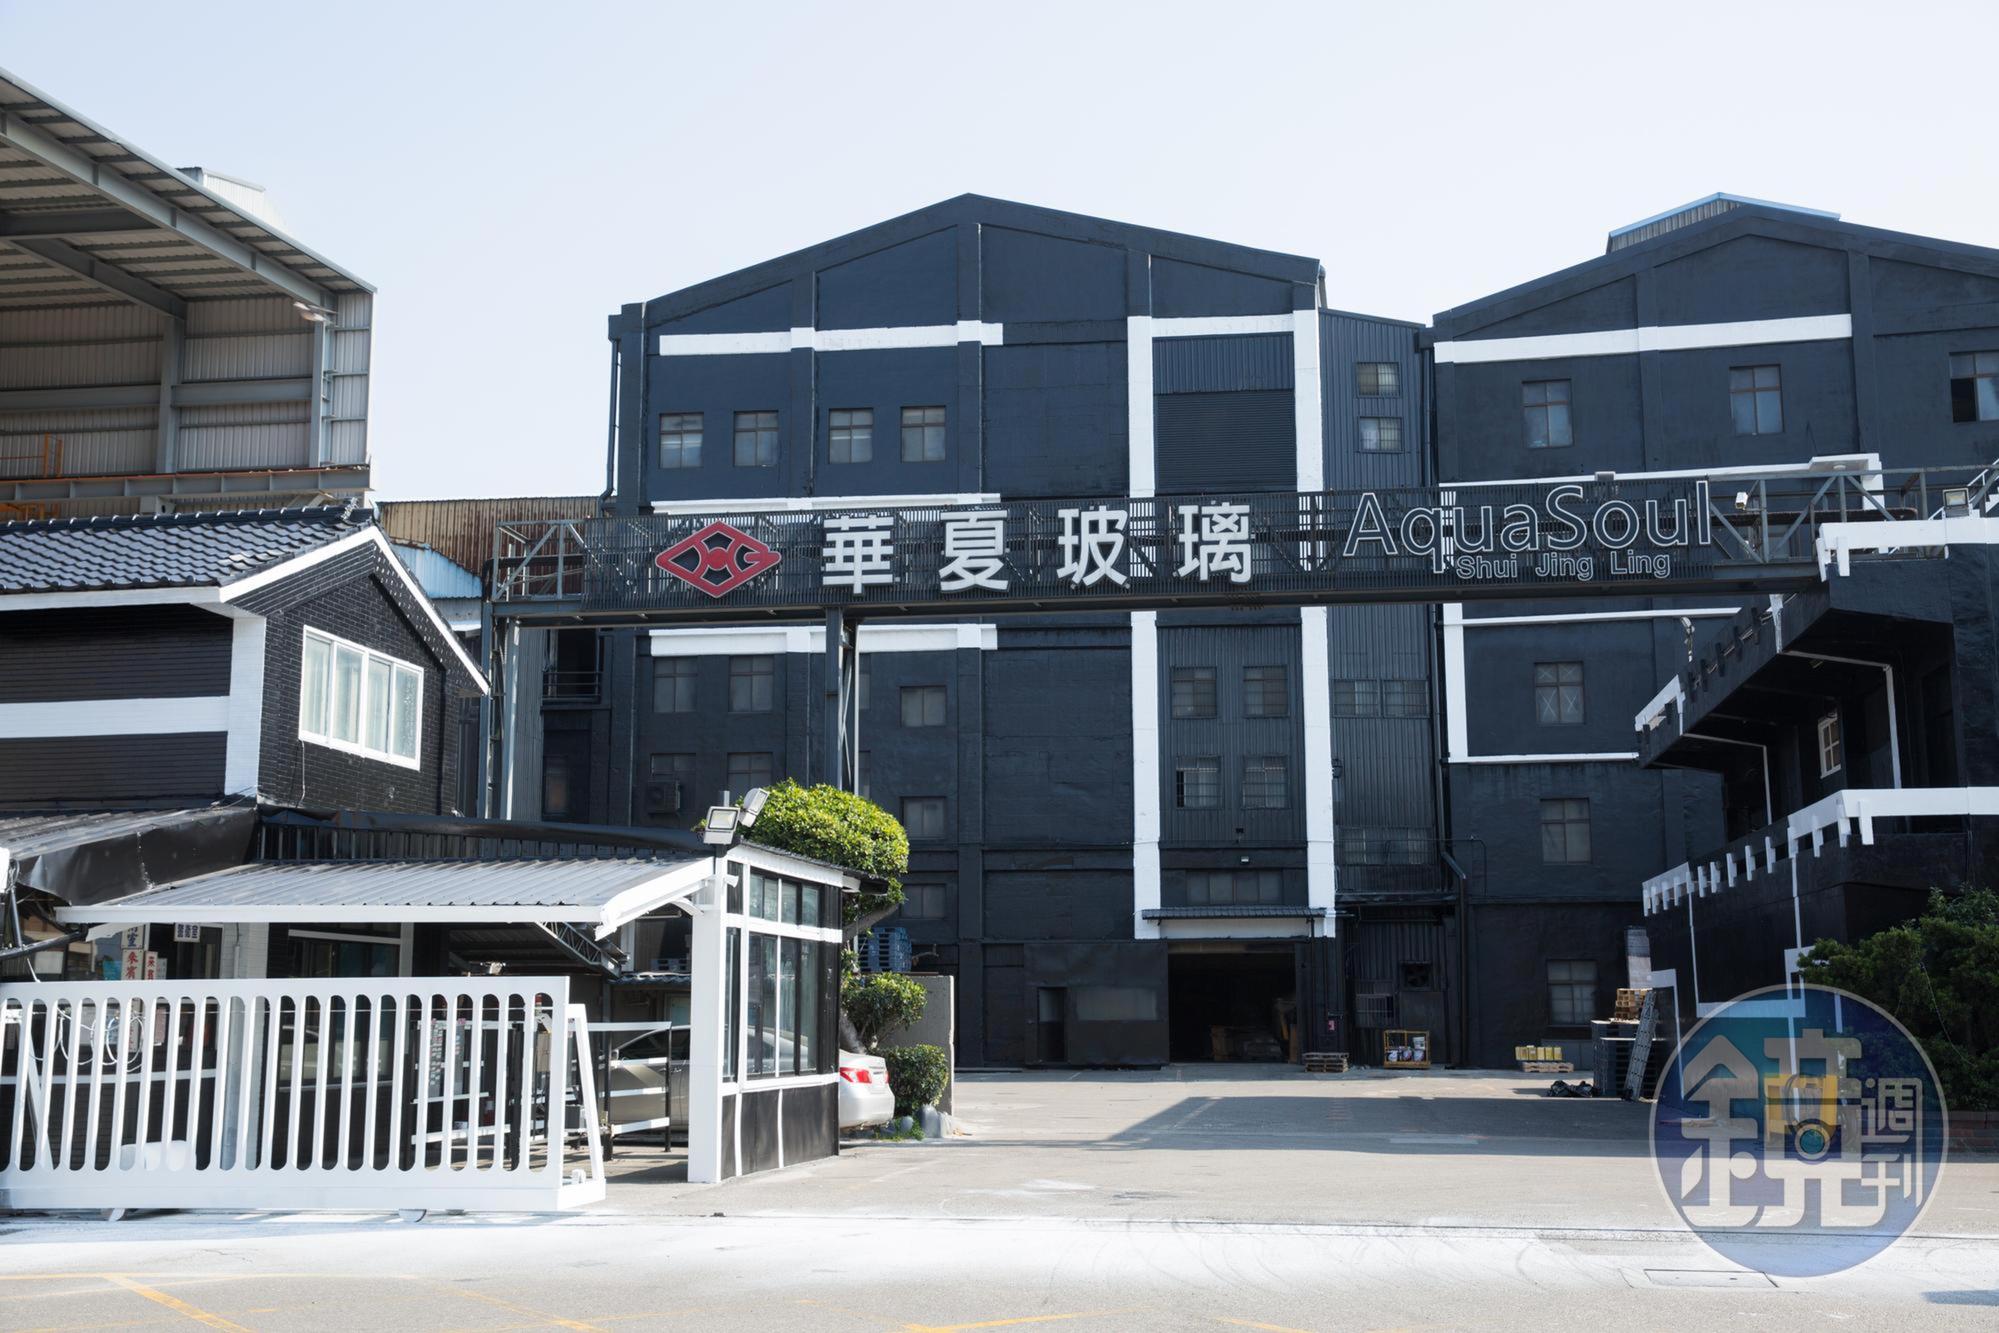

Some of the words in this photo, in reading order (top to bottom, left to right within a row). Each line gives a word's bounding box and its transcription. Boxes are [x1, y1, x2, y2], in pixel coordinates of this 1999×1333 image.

[822, 501, 1251, 596] 華夏玻璃
[1343, 481, 1711, 573] AquaSoul
[1456, 553, 1518, 579] Shui
[1535, 552, 1594, 581] Jing
[1610, 549, 1671, 579] Ling
